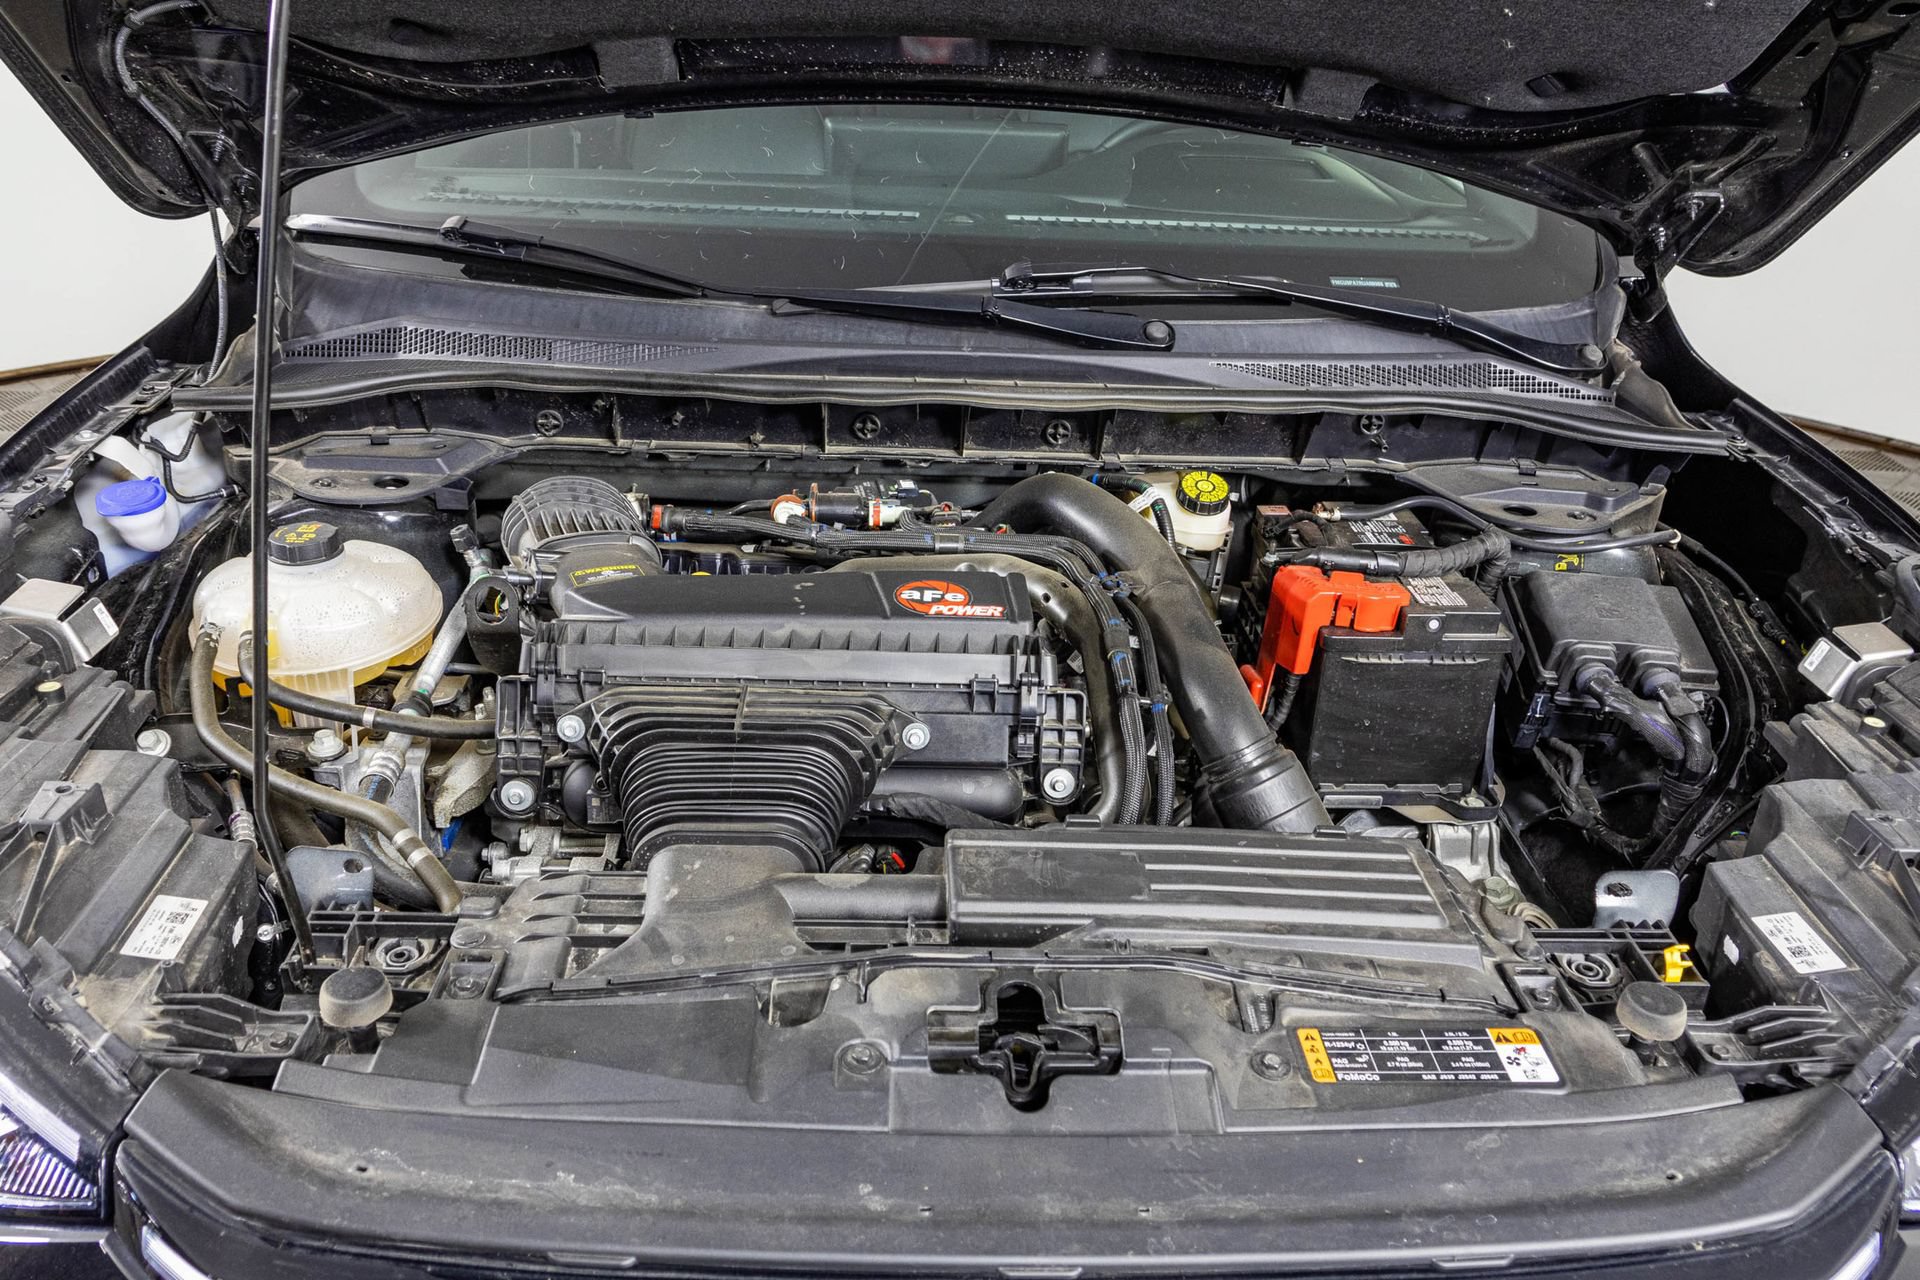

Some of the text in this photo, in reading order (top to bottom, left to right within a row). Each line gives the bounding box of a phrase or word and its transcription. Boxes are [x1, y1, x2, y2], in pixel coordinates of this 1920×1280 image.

[584, 564, 636, 574] WARNING
[900, 589, 965, 602] aFe
[928, 604, 1004, 616] POWER
[1336, 1073, 1380, 1081] FoMoCo
